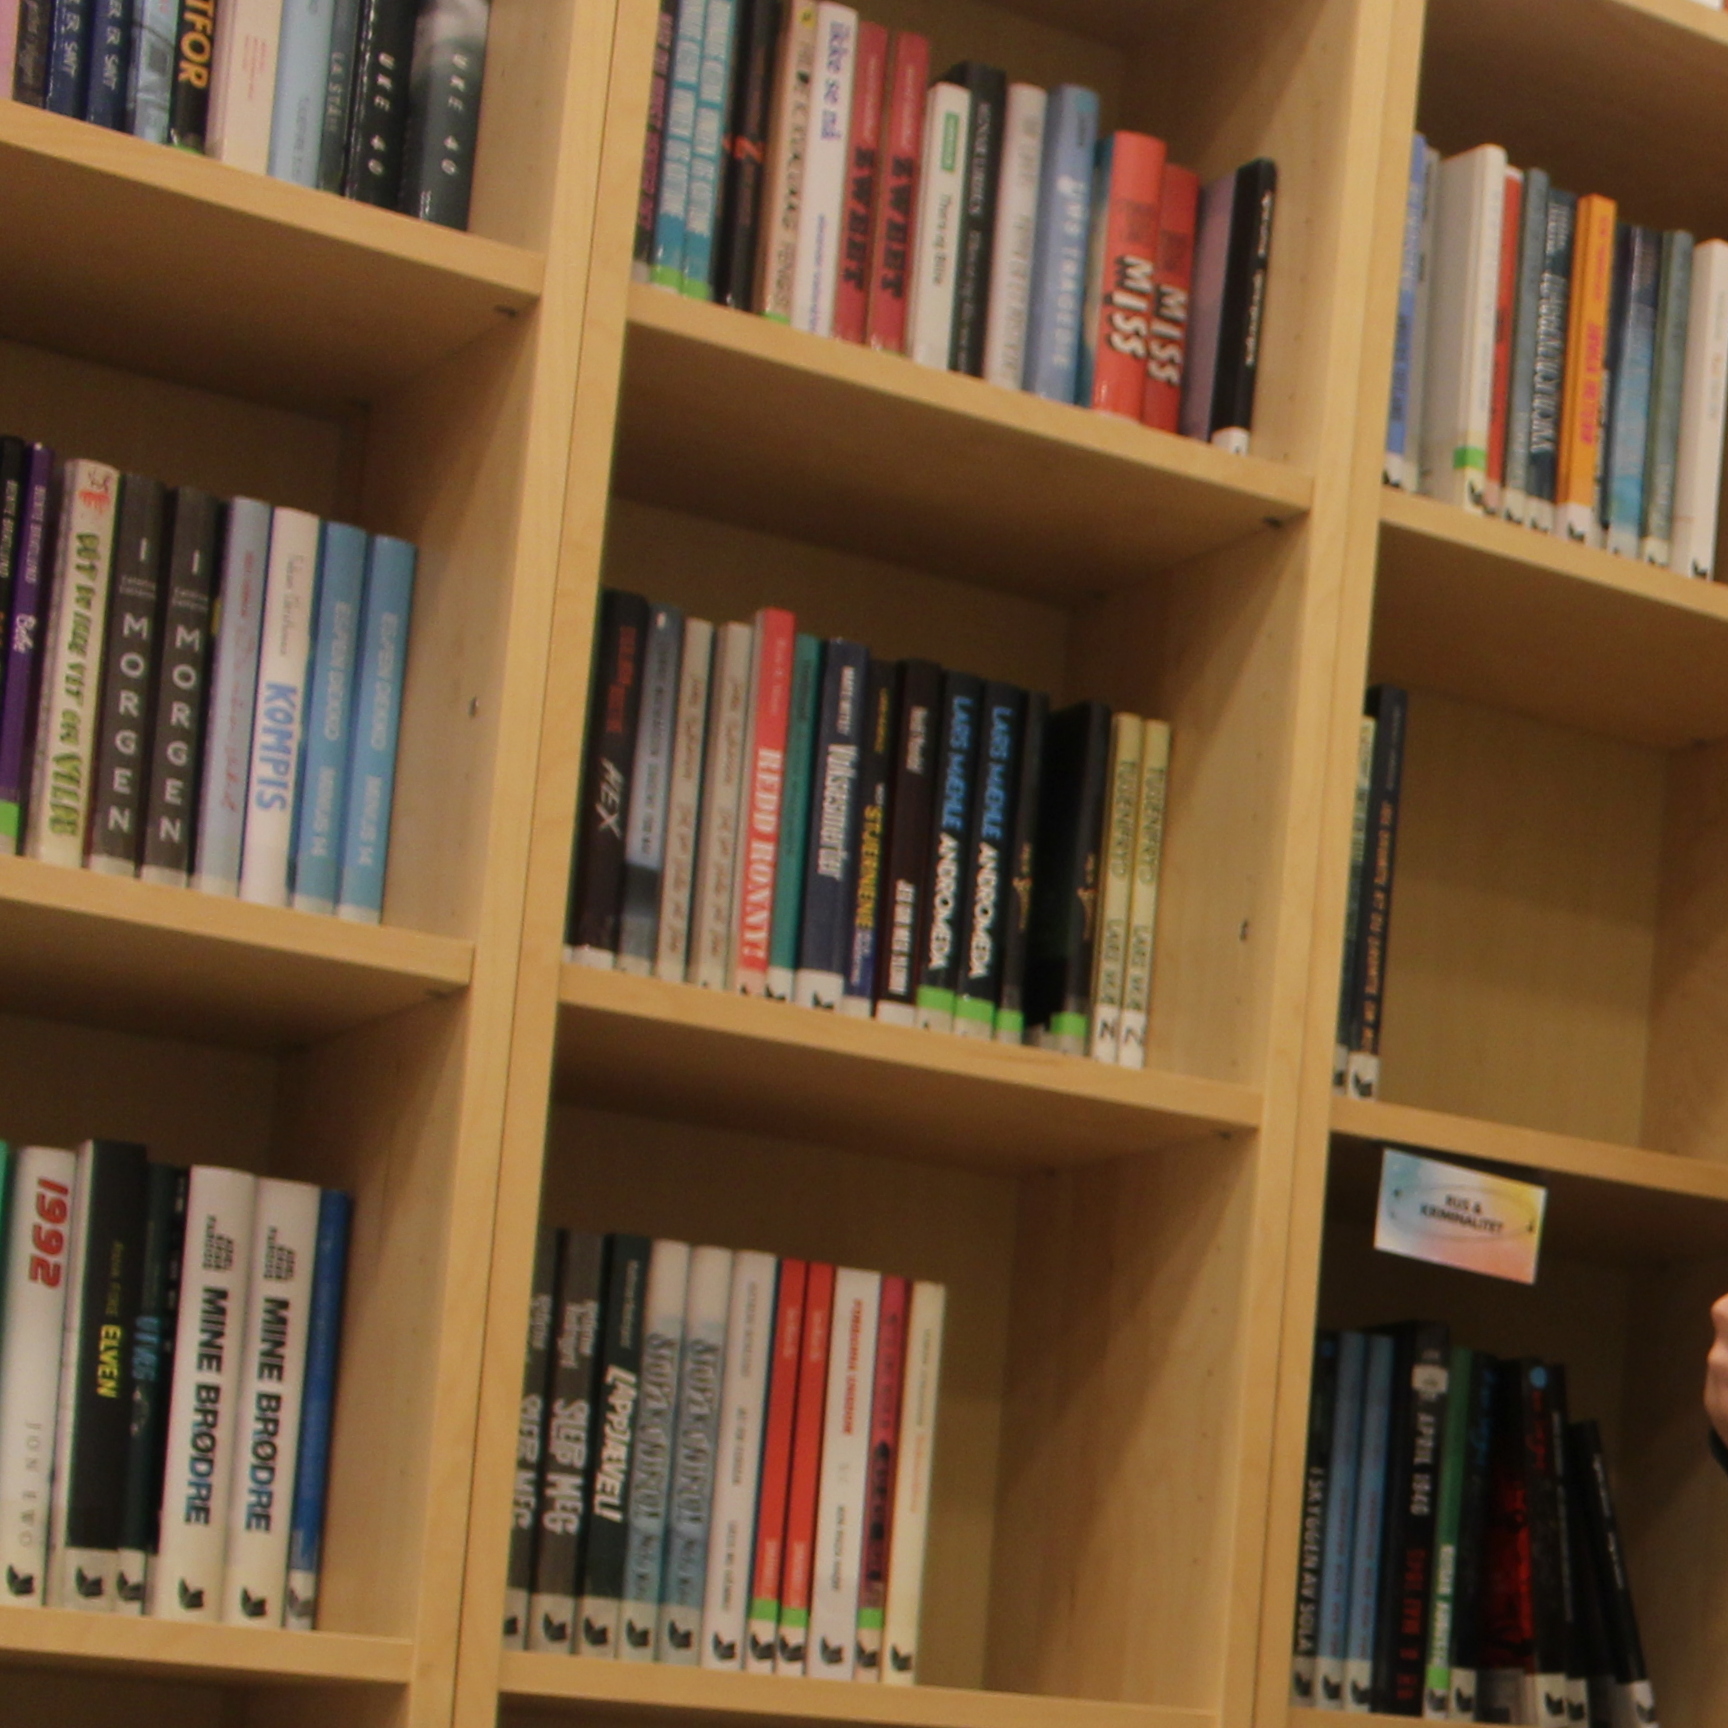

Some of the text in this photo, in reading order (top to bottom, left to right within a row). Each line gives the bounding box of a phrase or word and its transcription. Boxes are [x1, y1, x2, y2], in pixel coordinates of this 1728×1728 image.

[1110, 255, 1154, 361] MISS
[1147, 284, 1188, 386] MISS
[108, 614, 150, 834] MORGEN
[160, 625, 201, 844] MORGEN
[254, 681, 298, 812] KOMPIS
[948, 695, 974, 751] LARS
[987, 705, 1014, 761] LARS
[594, 757, 626, 841] HEX
[742, 746, 783, 959] REDD RONNY!
[927, 832, 961, 972] ANDROMEDA
[966, 841, 1001, 980] ANDROMEDA
[29, 1178, 70, 1290] 1992
[95, 1323, 124, 1400] ELVEN
[257, 1296, 291, 1383] MINE
[184, 1285, 230, 1527] MINE BRØDRE
[244, 1388, 283, 1534] BRØDRE
[592, 1364, 638, 1524] LAPPJÆVEL!
[541, 1473, 586, 1535] MEG
